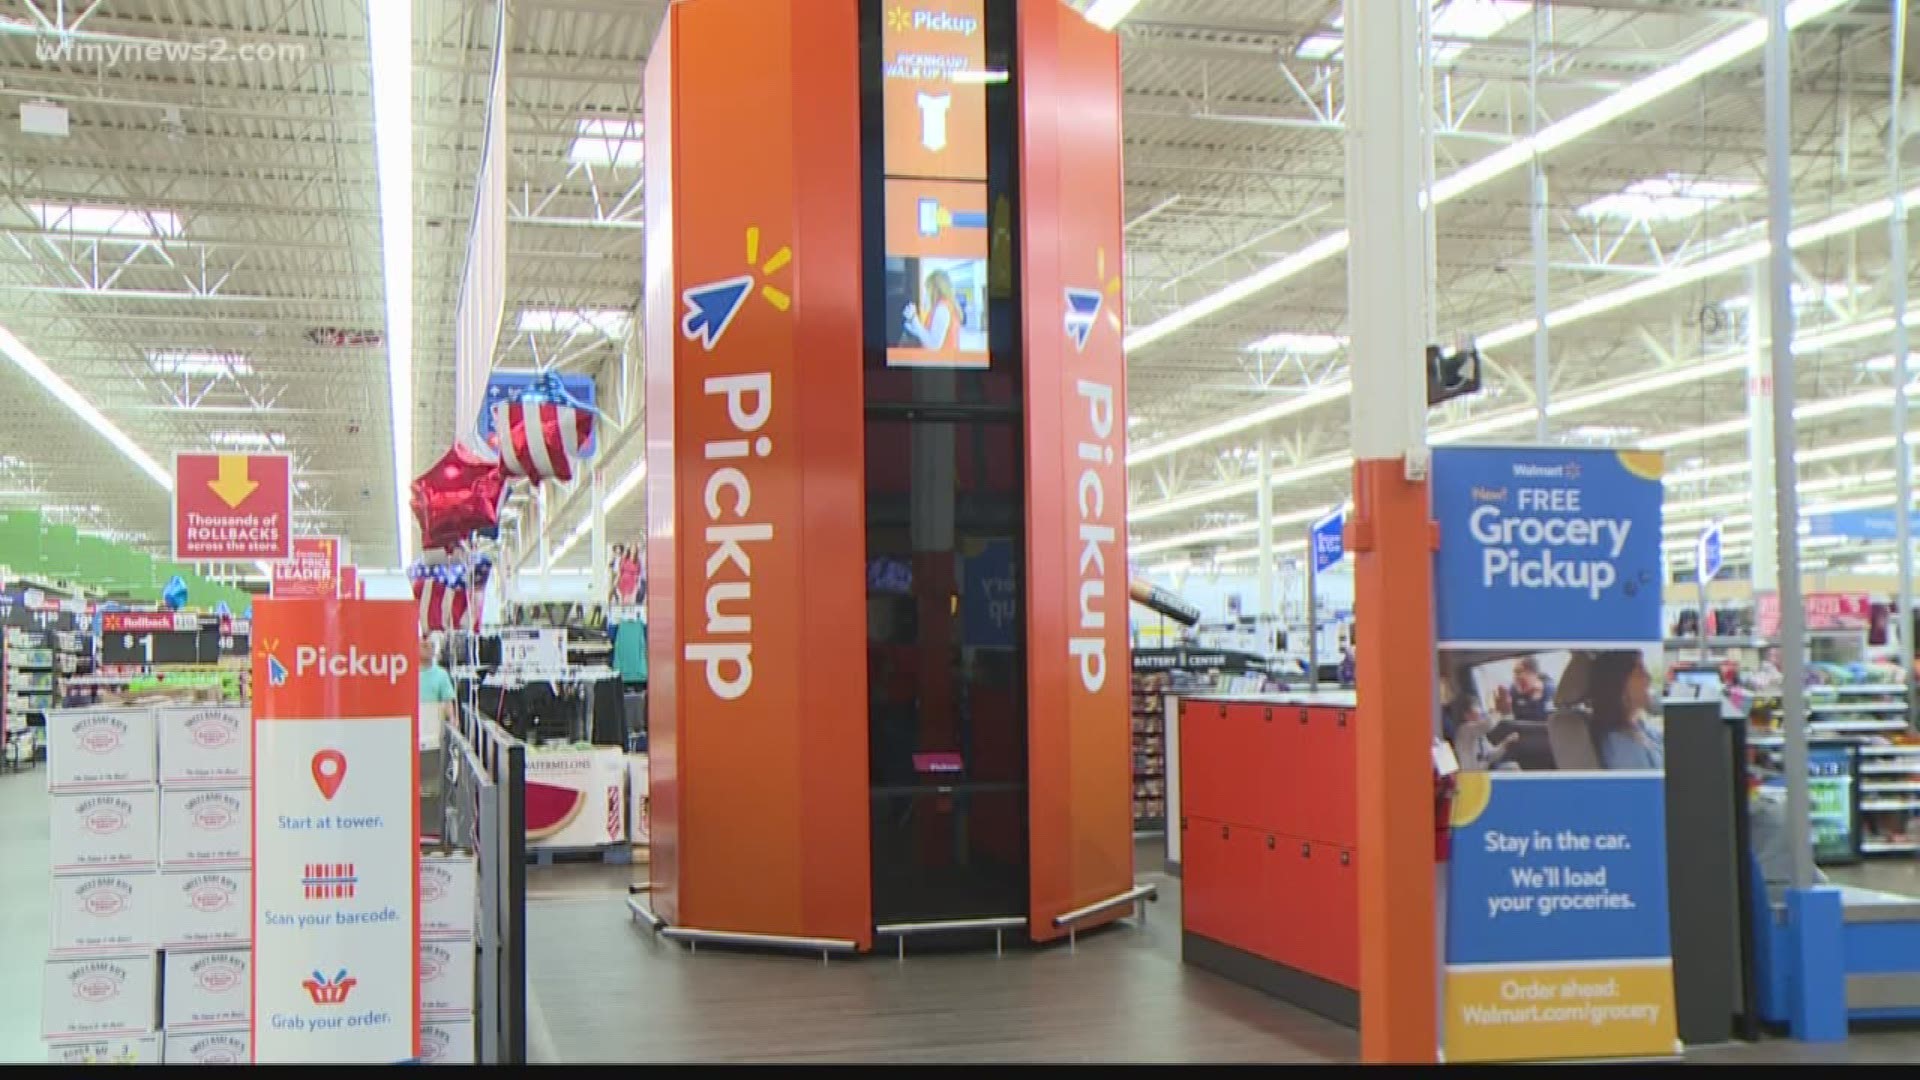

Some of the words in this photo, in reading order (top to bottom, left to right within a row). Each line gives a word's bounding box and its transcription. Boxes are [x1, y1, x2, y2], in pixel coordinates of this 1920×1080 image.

[914, 11, 977, 36] Pickup
[1512, 463, 1563, 477] Walmart
[1518, 489, 1582, 511] FREE
[187, 513, 260, 527] Thousands
[263, 513, 279, 527] of
[1469, 504, 1632, 558] Grocery
[187, 527, 279, 540] ROLLBACKS
[684, 372, 773, 699] Pickup
[1069, 379, 1115, 693] Pickup
[187, 541, 224, 551] across
[226, 540, 246, 551] the
[248, 541, 279, 551] store.
[276, 567, 331, 579] LEADER
[1483, 548, 1616, 600] Pickup
[123, 614, 170, 628] Rollback
[296, 645, 408, 685] Pickup
[1134, 655, 1177, 666] BATTERY
[1188, 655, 1225, 665] CENTER
[279, 815, 312, 829] Start
[316, 816, 331, 829] at
[336, 815, 384, 829] tower.
[1484, 831, 1530, 856] Stay
[1534, 831, 1553, 850] in
[1558, 830, 1590, 850] the
[1594, 833, 1631, 850] car.
[1511, 867, 1559, 888] We'll
[1565, 866, 1606, 887] load
[1488, 894, 1532, 917] your
[1538, 889, 1636, 916] groceries.
[265, 911, 294, 925] Scan
[298, 913, 332, 929] your
[336, 906, 400, 925] barcode.
[1502, 979, 1556, 1000] Order
[1560, 977, 1620, 998] ahead:
[272, 1013, 304, 1029] Grab
[309, 1017, 344, 1032] your
[347, 1009, 391, 1027] order.
[1462, 1001, 1660, 1025] Walmart.com/grocery
